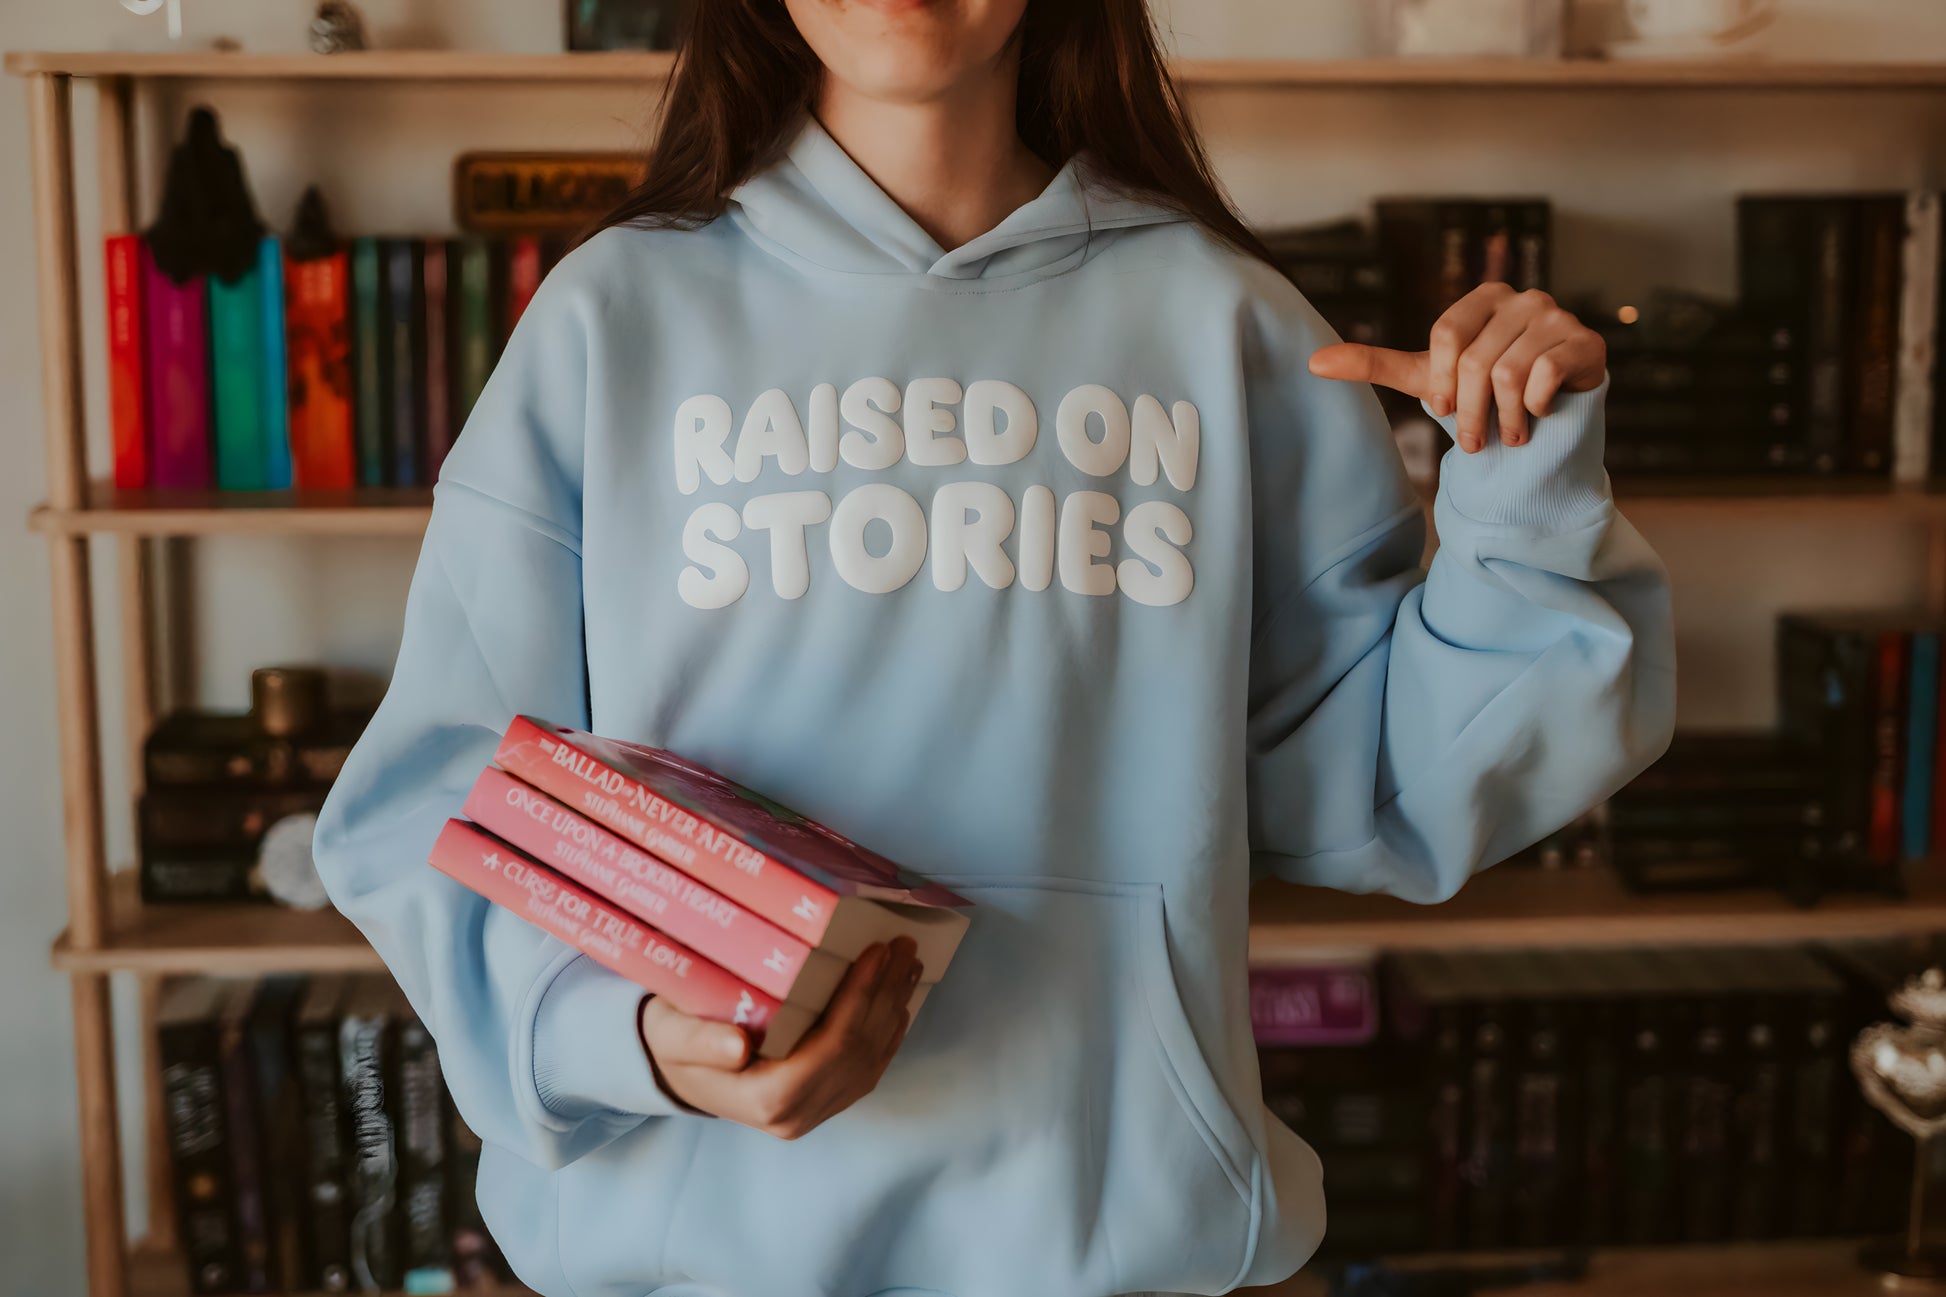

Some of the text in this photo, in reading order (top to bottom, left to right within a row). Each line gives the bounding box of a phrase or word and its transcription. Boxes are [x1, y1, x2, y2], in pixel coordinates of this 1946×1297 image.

[674, 376, 1200, 495] RAISED ON
[677, 481, 1195, 610] STORIES
[503, 785, 739, 931] ONCE UPON A BROKEN HEART
[551, 742, 627, 798] BALLAD
[627, 785, 701, 840] NEVER
[694, 823, 767, 878] AFTER
[477, 847, 694, 979] A CURSE FOR TRUE LOVE
